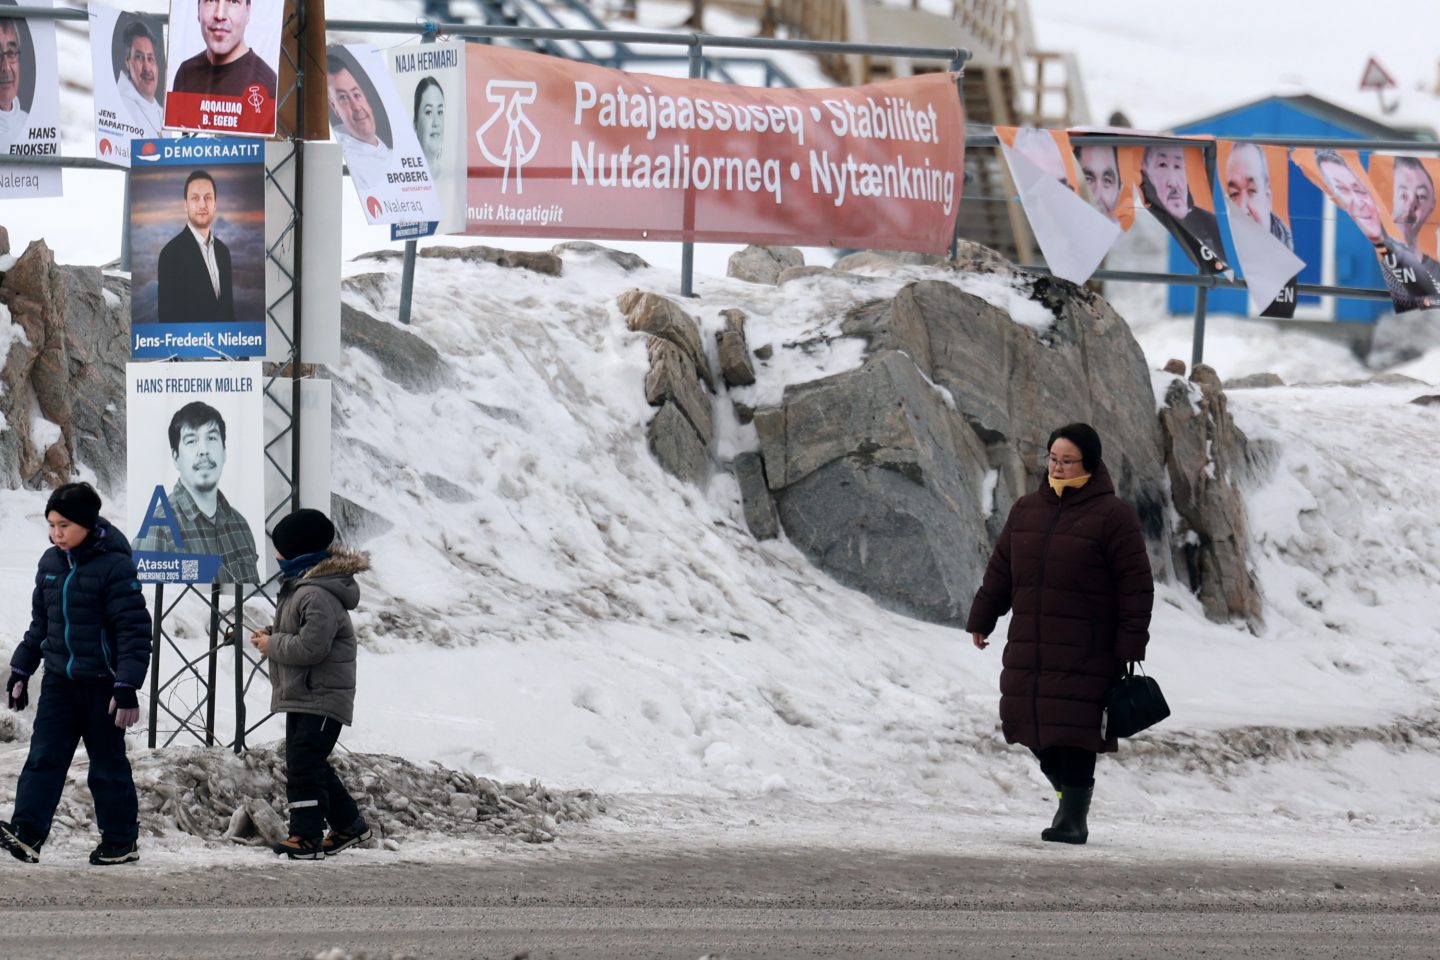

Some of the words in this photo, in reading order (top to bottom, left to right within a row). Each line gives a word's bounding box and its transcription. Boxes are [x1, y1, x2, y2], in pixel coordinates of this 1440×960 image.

[395, 54, 416, 73] NAJA
[417, 49, 458, 71] HERMARIJ
[98, 109, 116, 119] JENS
[200, 100, 242, 115] AQQALUAQ
[574, 81, 804, 145] Patajaassuseq
[822, 99, 939, 143] Stabilitet
[98, 119, 145, 137] NAPAATTOOQ
[202, 114, 211, 125] B.
[213, 115, 238, 127] EGEDE
[28, 127, 57, 139] HANS
[10, 143, 57, 155] ENOKSEN
[164, 144, 259, 158] DEMOKRAATIT
[401, 157, 423, 168] PELE
[387, 171, 428, 183] BROBERG
[571, 141, 782, 204] Nutaaliorneq
[810, 150, 955, 216] Nytænkning
[384, 198, 423, 214] Naleraq
[496, 204, 564, 225] Ataqatigiit
[135, 333, 215, 350] Jens-Frederik
[218, 332, 262, 347] Nielsen
[136, 379, 163, 393] HANS
[165, 379, 213, 393] FREDERIK
[215, 378, 253, 392] MØLLER
[136, 558, 180, 571] Atassut
